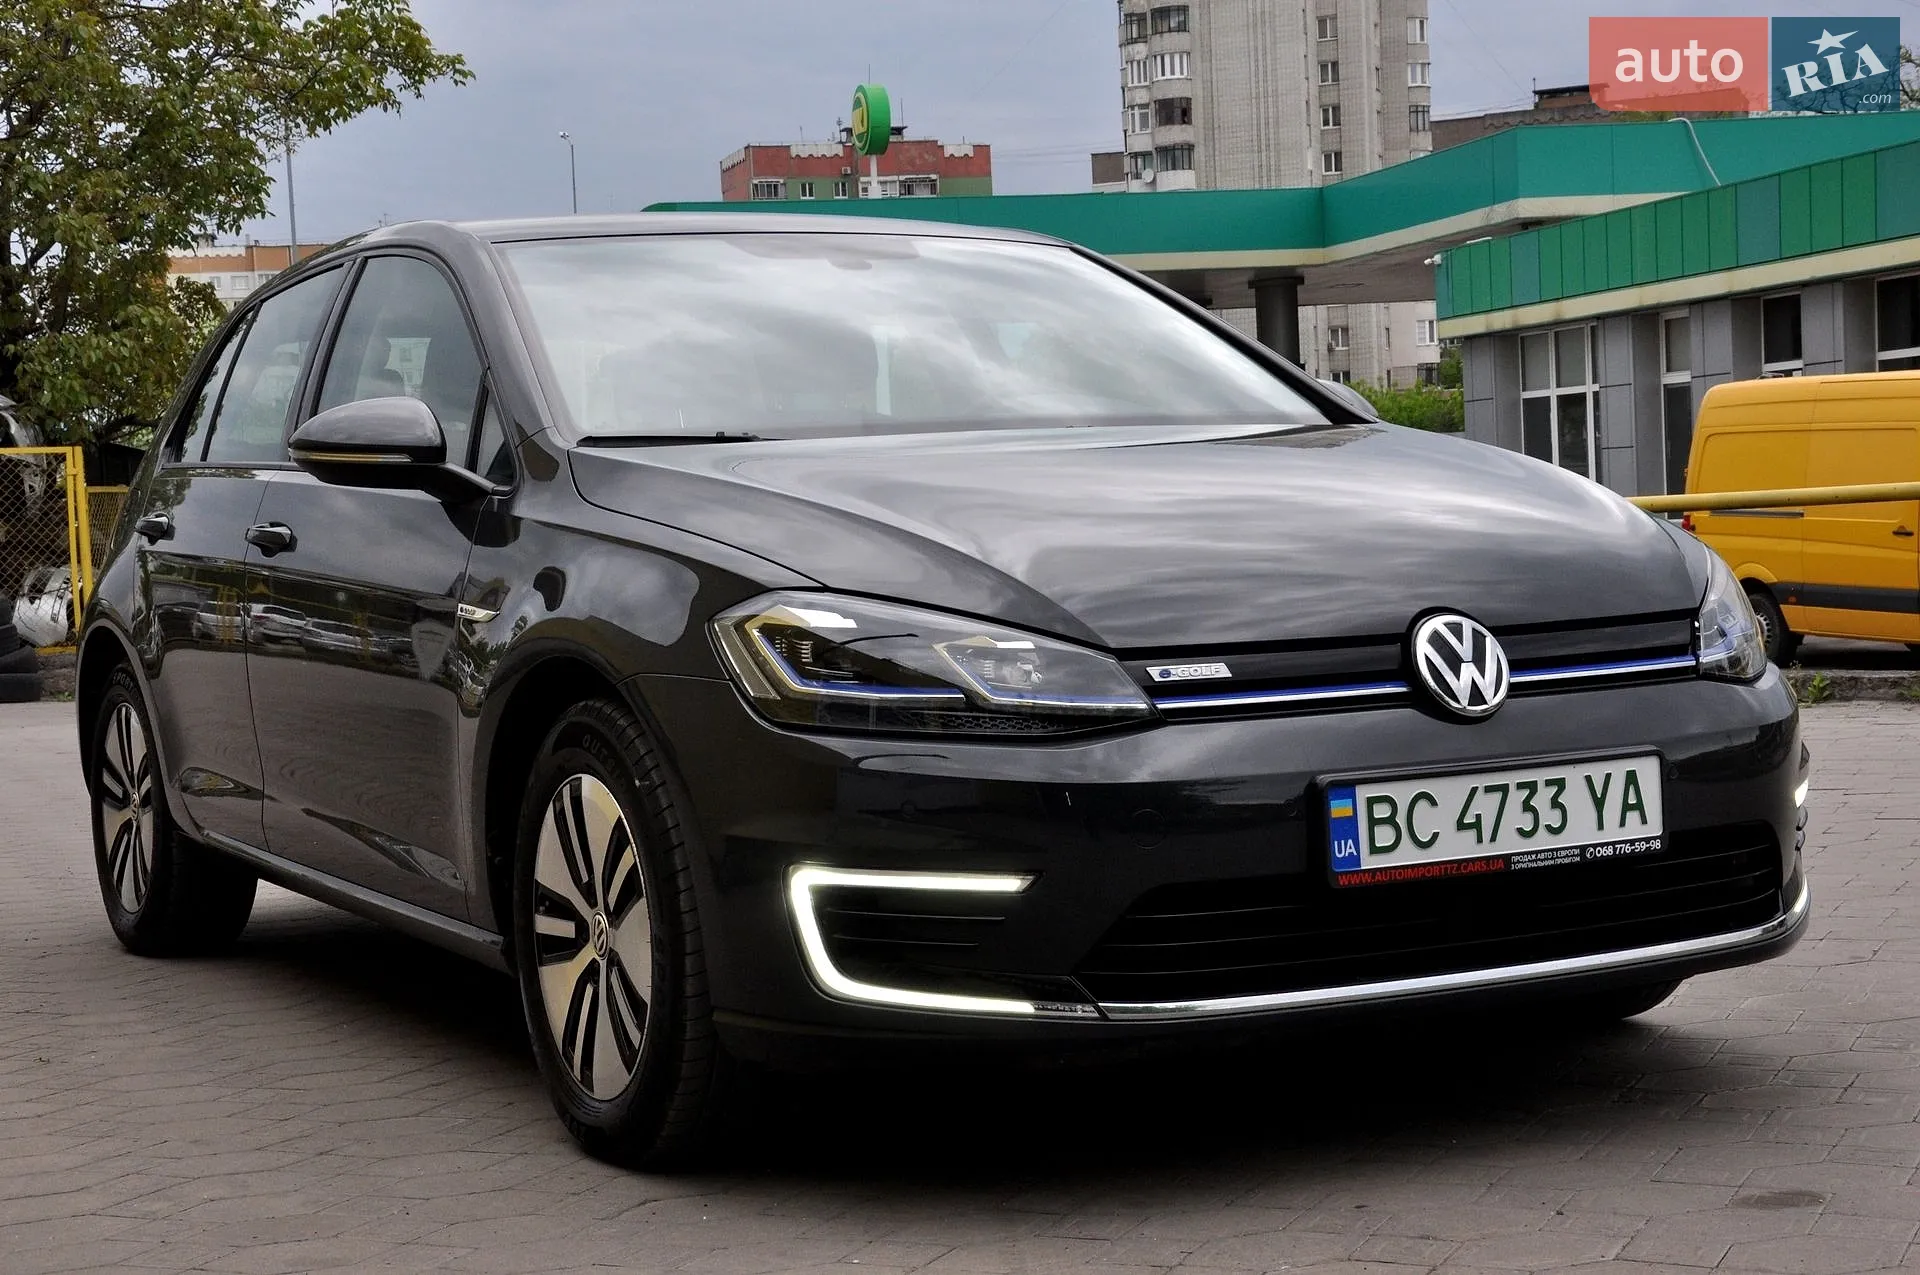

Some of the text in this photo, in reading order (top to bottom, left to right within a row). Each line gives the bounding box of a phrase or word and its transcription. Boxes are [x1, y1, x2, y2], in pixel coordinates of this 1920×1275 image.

[1159, 665, 1221, 678] e-GOLF
[1366, 769, 1649, 855] BC 4733 YA
[1334, 839, 1358, 858] UA
[1595, 839, 1662, 857] 068 776-59-98
[1338, 859, 1505, 887] WWW.AUTOIMPORTTZ.CARS.UA
